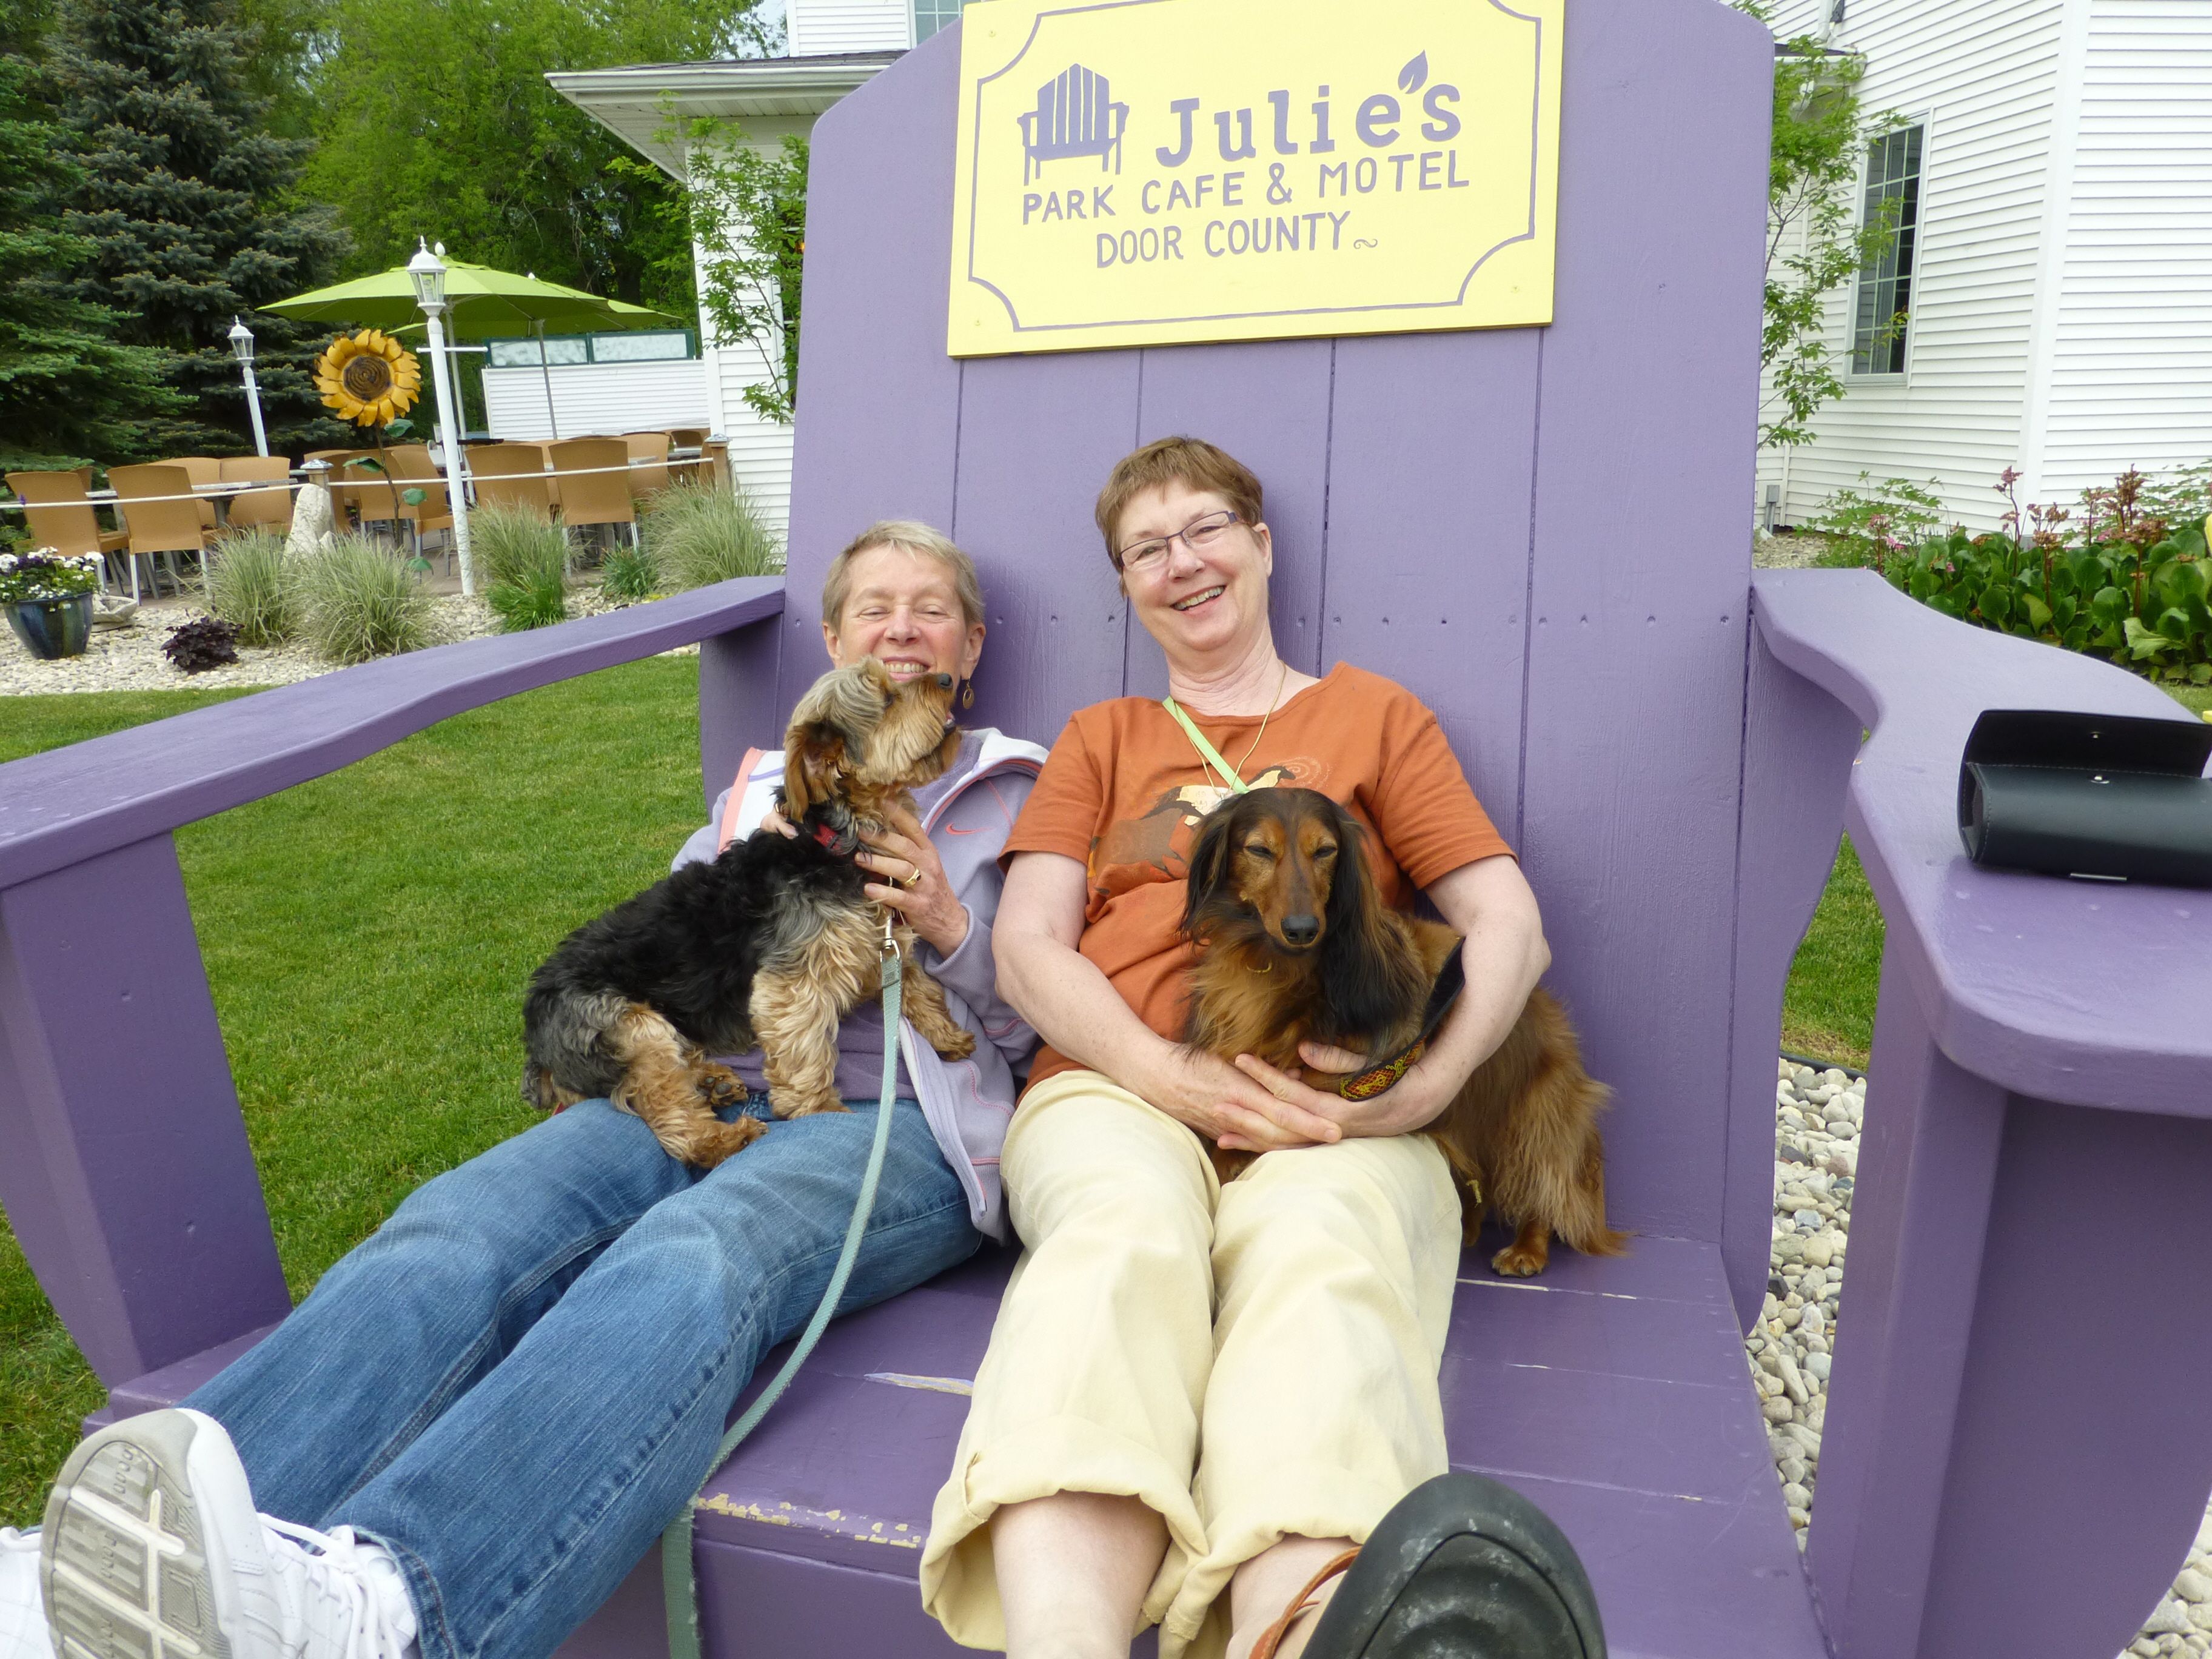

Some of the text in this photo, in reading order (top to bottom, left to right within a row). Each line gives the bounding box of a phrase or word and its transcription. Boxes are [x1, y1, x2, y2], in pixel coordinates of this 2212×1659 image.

[1155, 50, 1461, 168] Julie's
[1022, 149, 1470, 226] PARK CAFE & MOTEL
[1096, 210, 1352, 269] DOOR COUNTY
